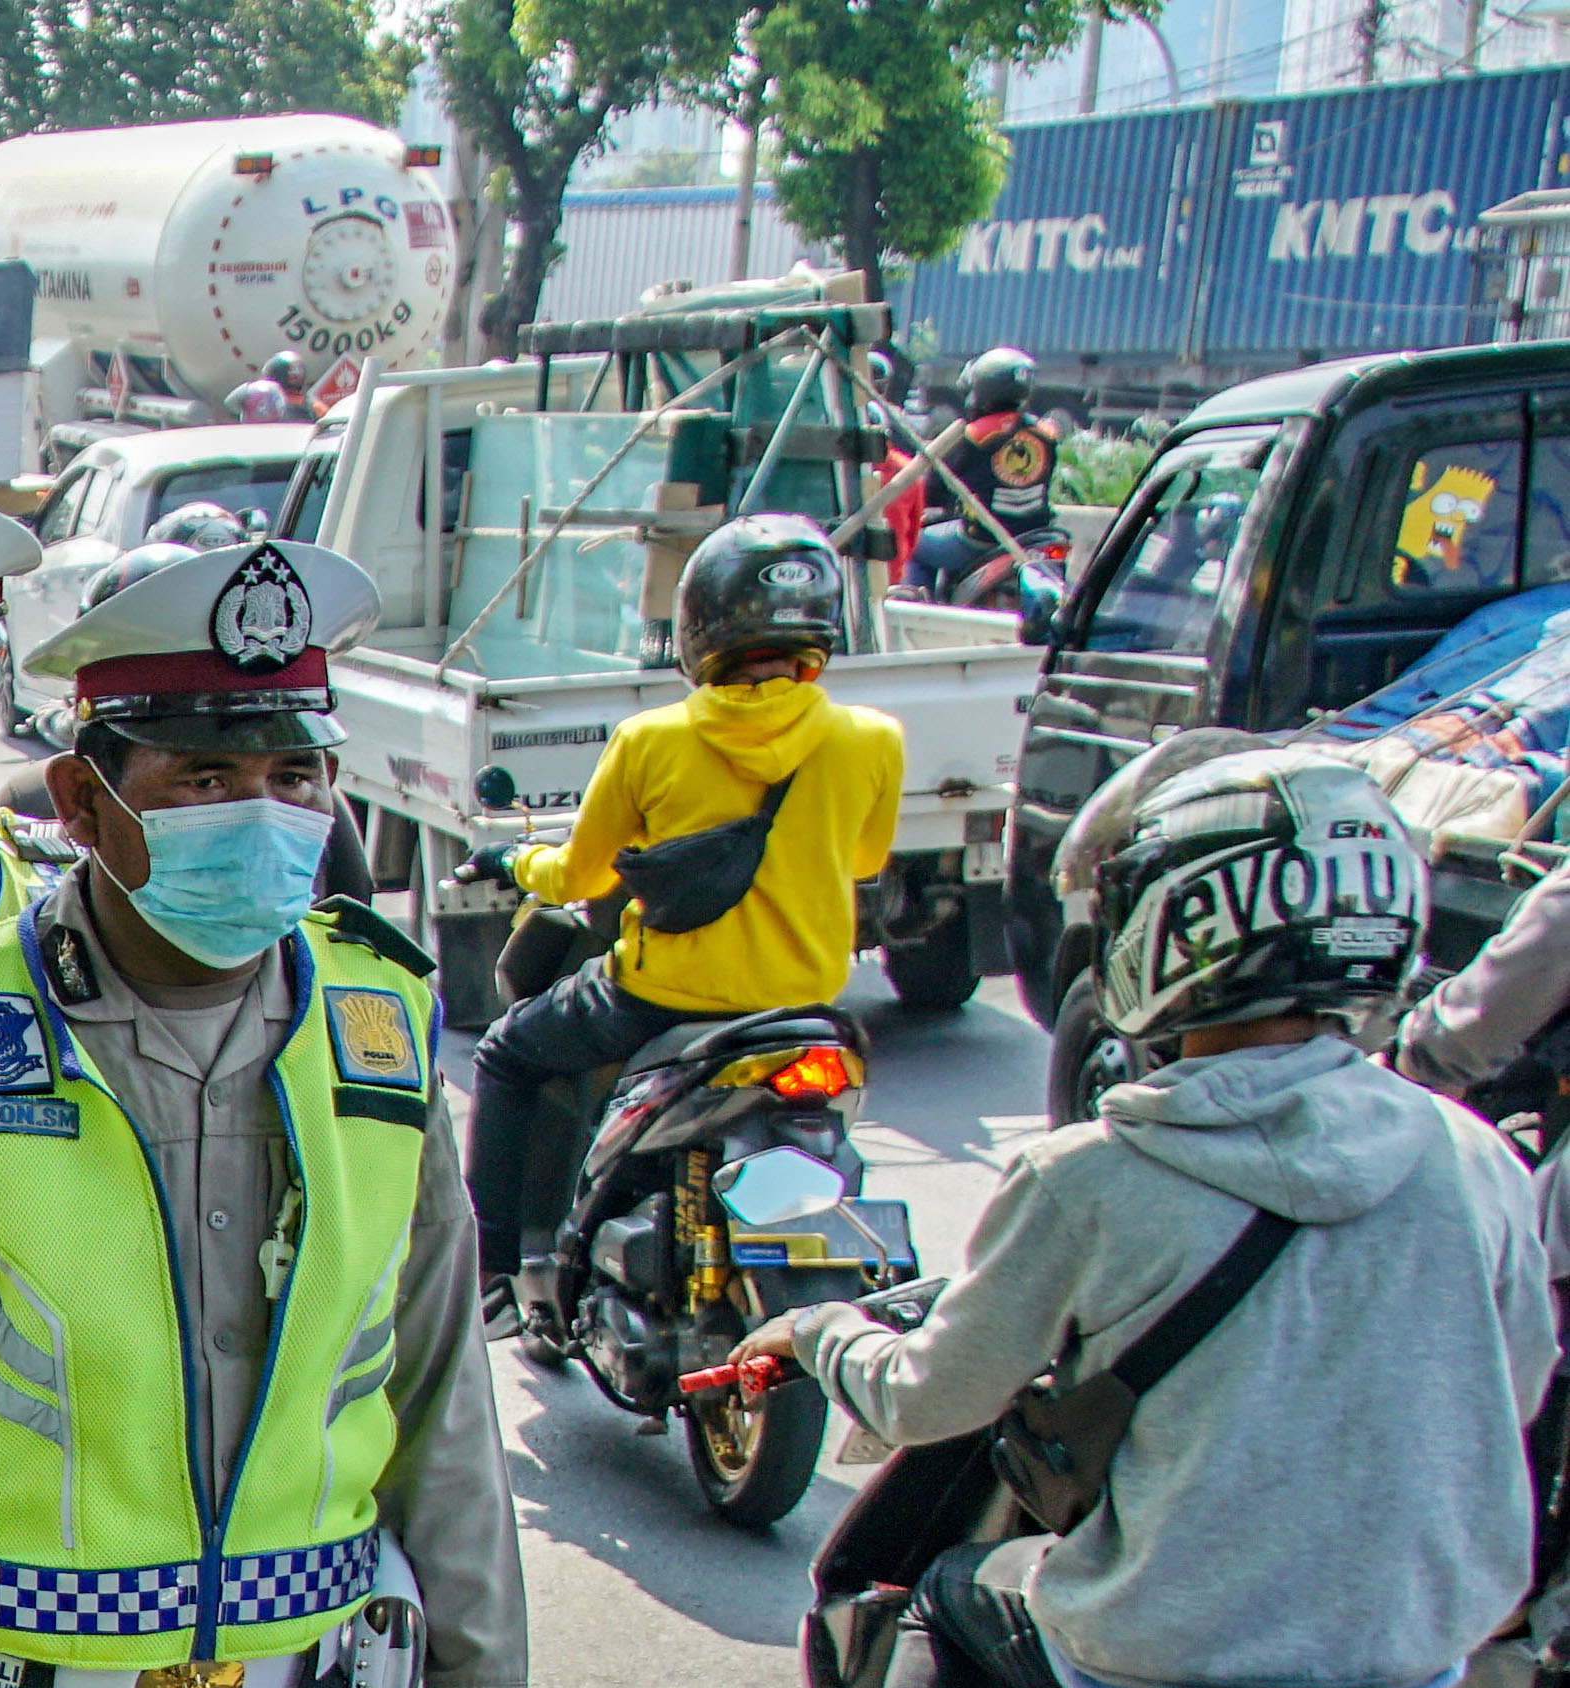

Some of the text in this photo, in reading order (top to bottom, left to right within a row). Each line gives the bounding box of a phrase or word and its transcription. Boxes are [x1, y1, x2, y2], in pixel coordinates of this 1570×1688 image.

[301, 187, 399, 219] LPG
[1269, 190, 1456, 261] KMTC
[958, 214, 1108, 275] KMTC
[277, 299, 412, 357] 15000kg
